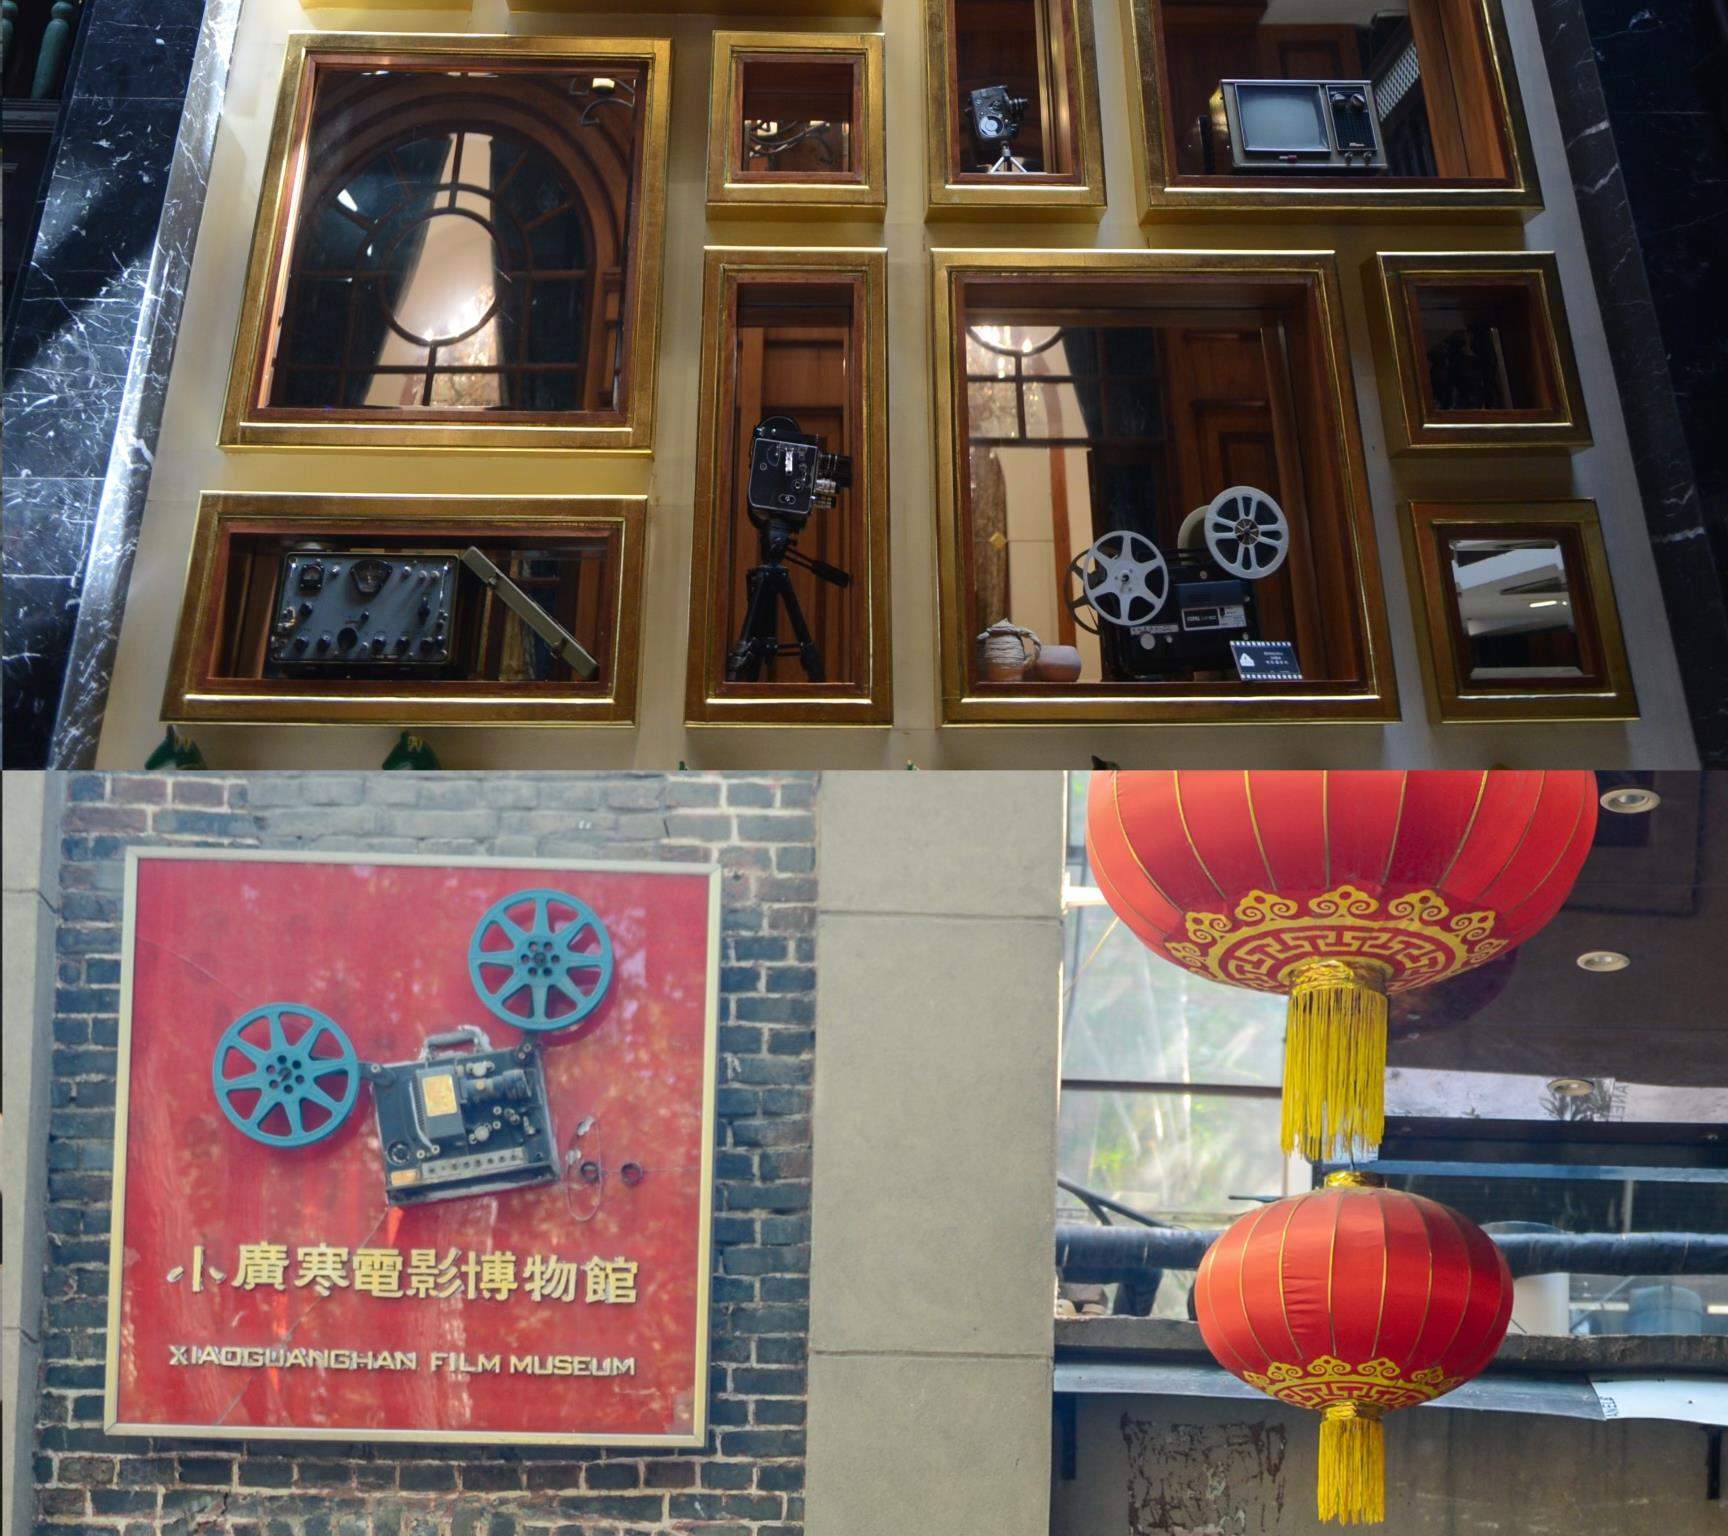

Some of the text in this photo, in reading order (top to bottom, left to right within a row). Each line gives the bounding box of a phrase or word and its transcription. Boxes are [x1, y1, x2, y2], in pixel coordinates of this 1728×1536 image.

[167, 1240, 639, 1305] 小廣寒電影博物館
[168, 1344, 636, 1377] XIAOGUANGHAN FILM MUSEUM
